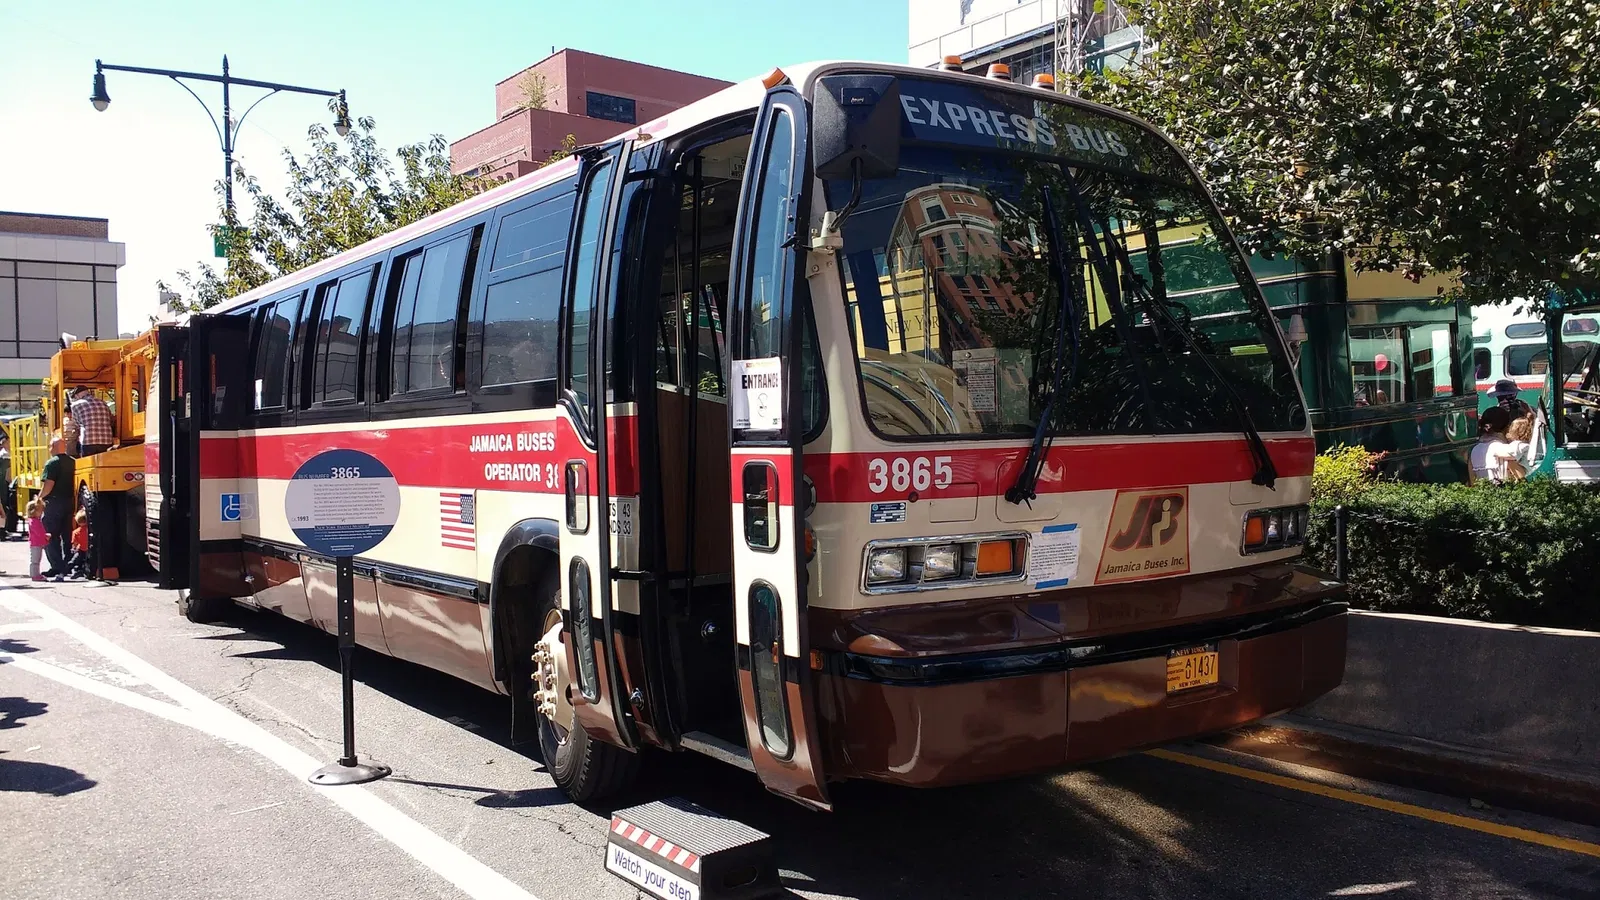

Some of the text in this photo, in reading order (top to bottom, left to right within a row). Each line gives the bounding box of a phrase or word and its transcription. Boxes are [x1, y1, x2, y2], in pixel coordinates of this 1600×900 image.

[899, 94, 1130, 157] EXPRESS BUS
[741, 373, 779, 390] ENTRANCE
[469, 431, 555, 453] JAMAICA BUSES
[331, 467, 360, 479] 3865
[484, 463, 541, 482] OPERATOR
[869, 456, 952, 493] 3865
[622, 503, 631, 518] 43
[623, 520, 632, 535] 33
[1104, 556, 1185, 575] Jamaica Buses Inc.
[615, 848, 691, 900] Watch your step
